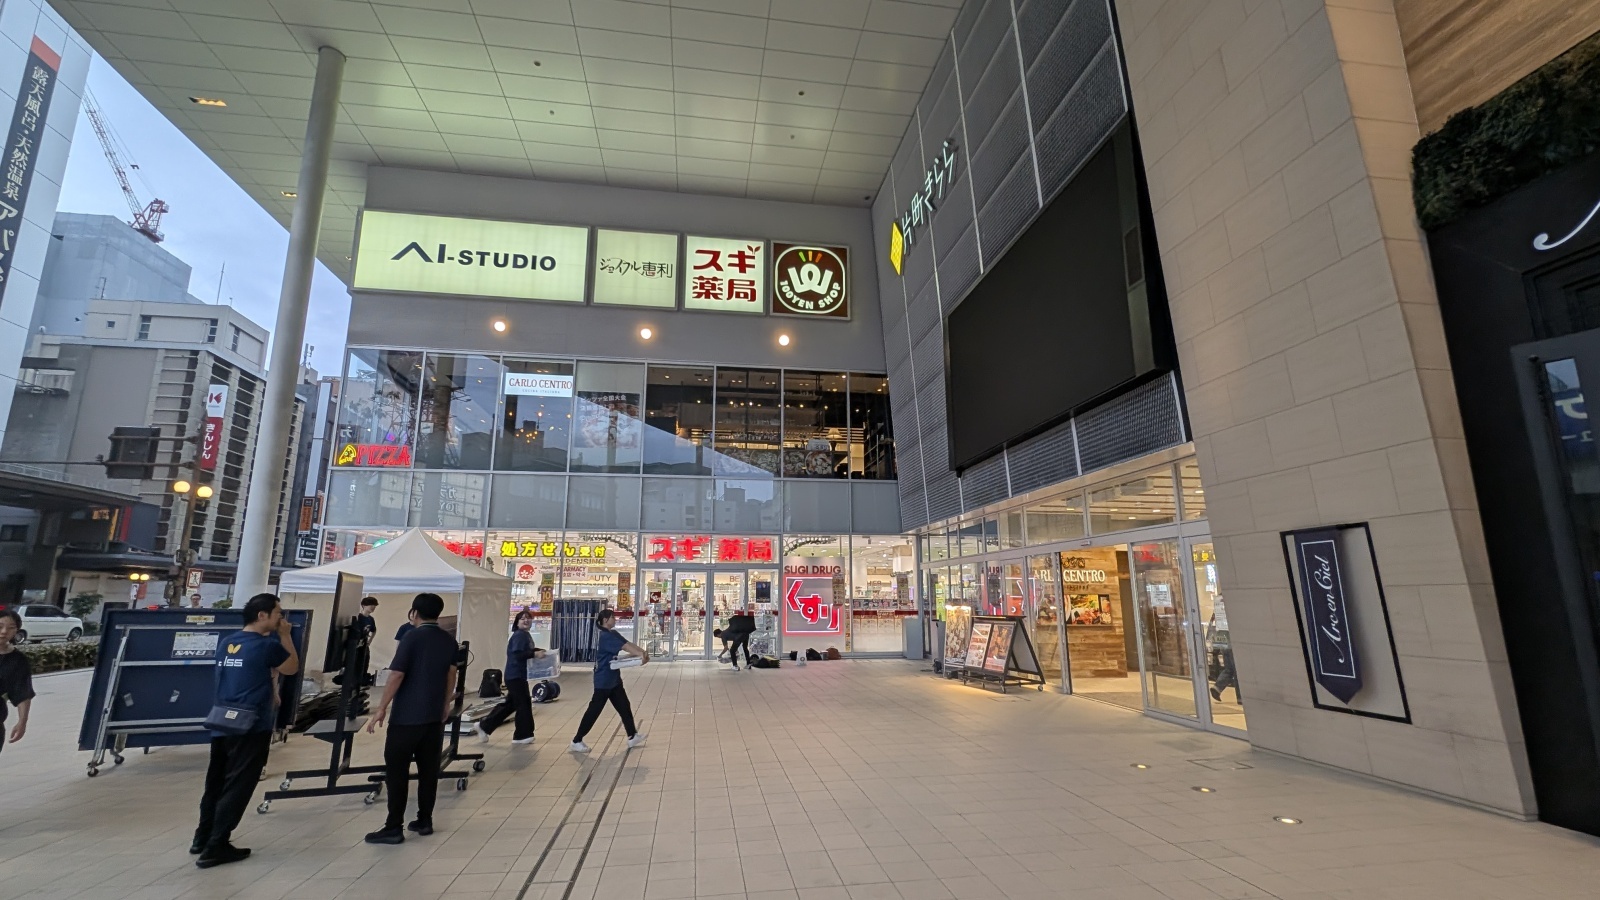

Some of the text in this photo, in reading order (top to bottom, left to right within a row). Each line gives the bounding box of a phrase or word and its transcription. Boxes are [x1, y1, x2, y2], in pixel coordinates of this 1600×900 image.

[3, 64, 50, 202] 露天風呂・天然温泉
[901, 140, 954, 255] 片町きらら
[390, 241, 557, 272] AI-STUDIO
[599, 257, 674, 279] ジョイフル恵利
[693, 245, 761, 274] スギ
[692, 275, 757, 303] 薬局
[780, 280, 841, 310] 100YEN SHOP
[508, 377, 573, 390] CARLO CENTRO
[201, 423, 216, 460] きんしん
[355, 444, 411, 466] PIZZA
[500, 541, 607, 558] 処方せん受付
[550, 557, 606, 565] DIPENSING
[784, 564, 842, 576] SUGI DRUG
[1063, 569, 1106, 582] CENTRO
